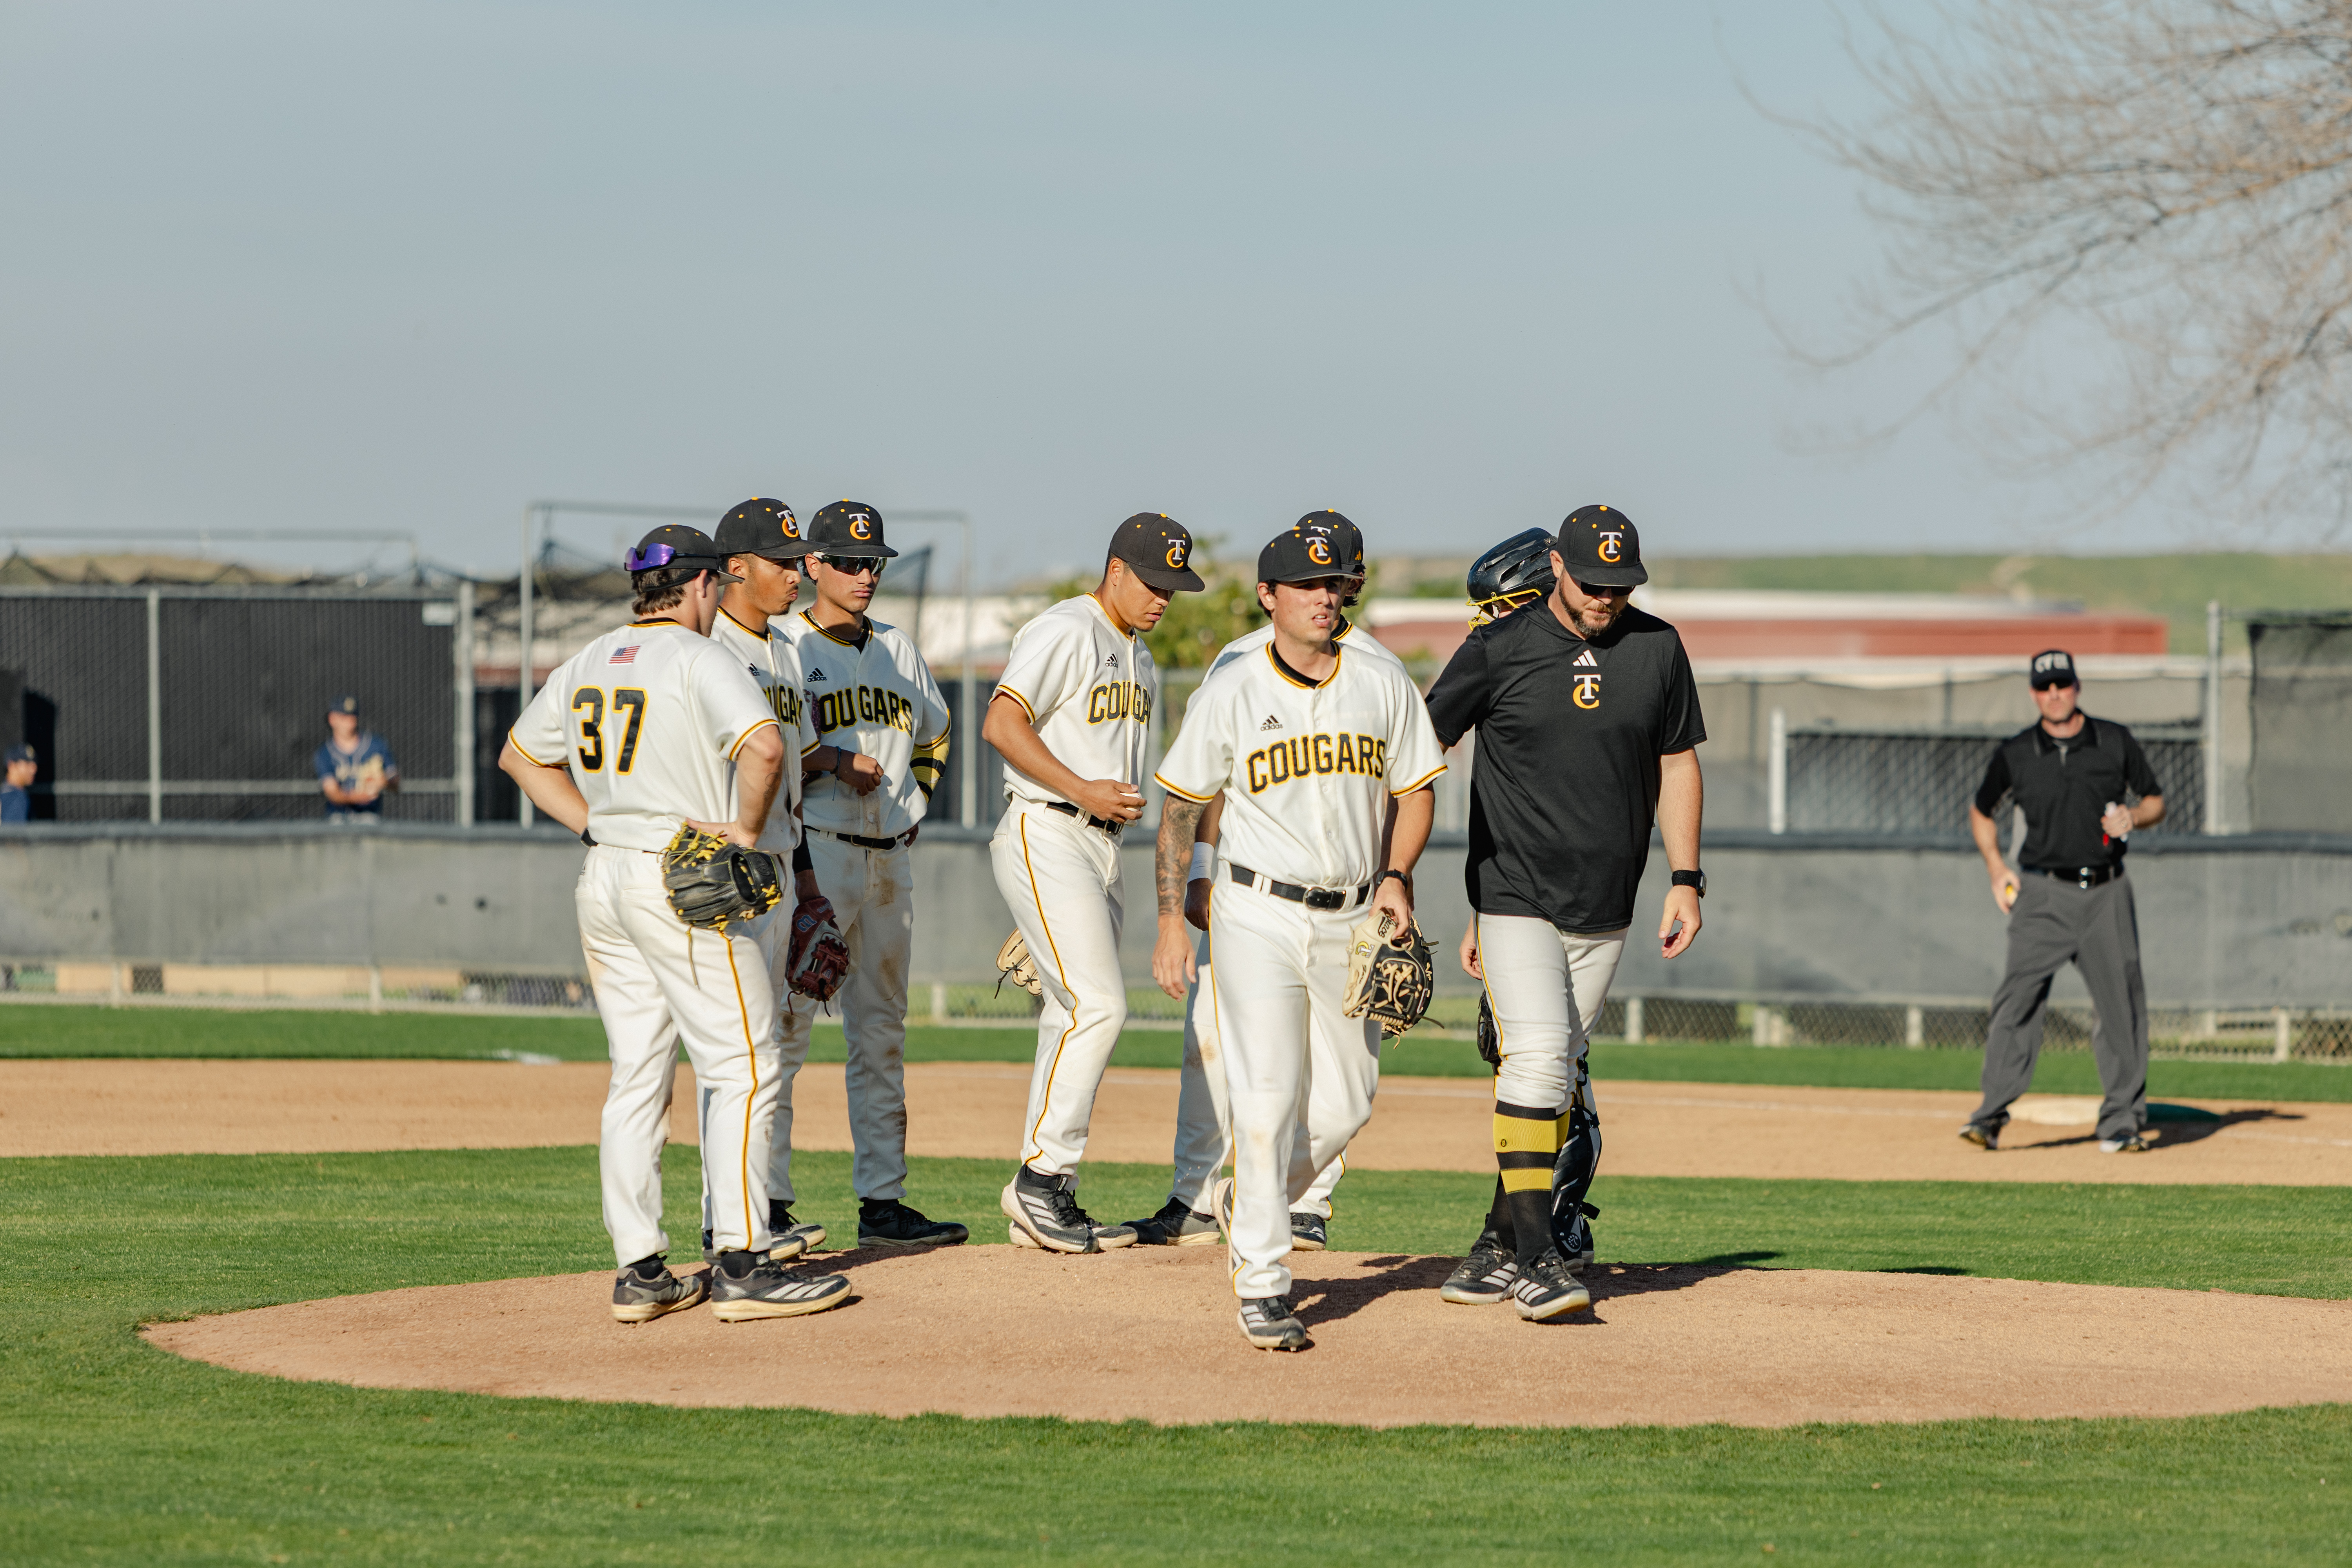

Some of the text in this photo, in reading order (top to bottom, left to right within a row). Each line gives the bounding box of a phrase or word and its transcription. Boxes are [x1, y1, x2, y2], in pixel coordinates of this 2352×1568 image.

[777, 510, 799, 537] TC
[849, 514, 871, 540] TC
[1166, 539, 1185, 568] TC
[1305, 537, 1332, 564] TC
[1598, 532, 1622, 562] TC
[1573, 674, 1601, 709] TC
[818, 684, 913, 739] OUGARS
[571, 685, 648, 775] 37
[1260, 722, 1283, 731] adidas
[1246, 732, 1386, 795] COUGARS
